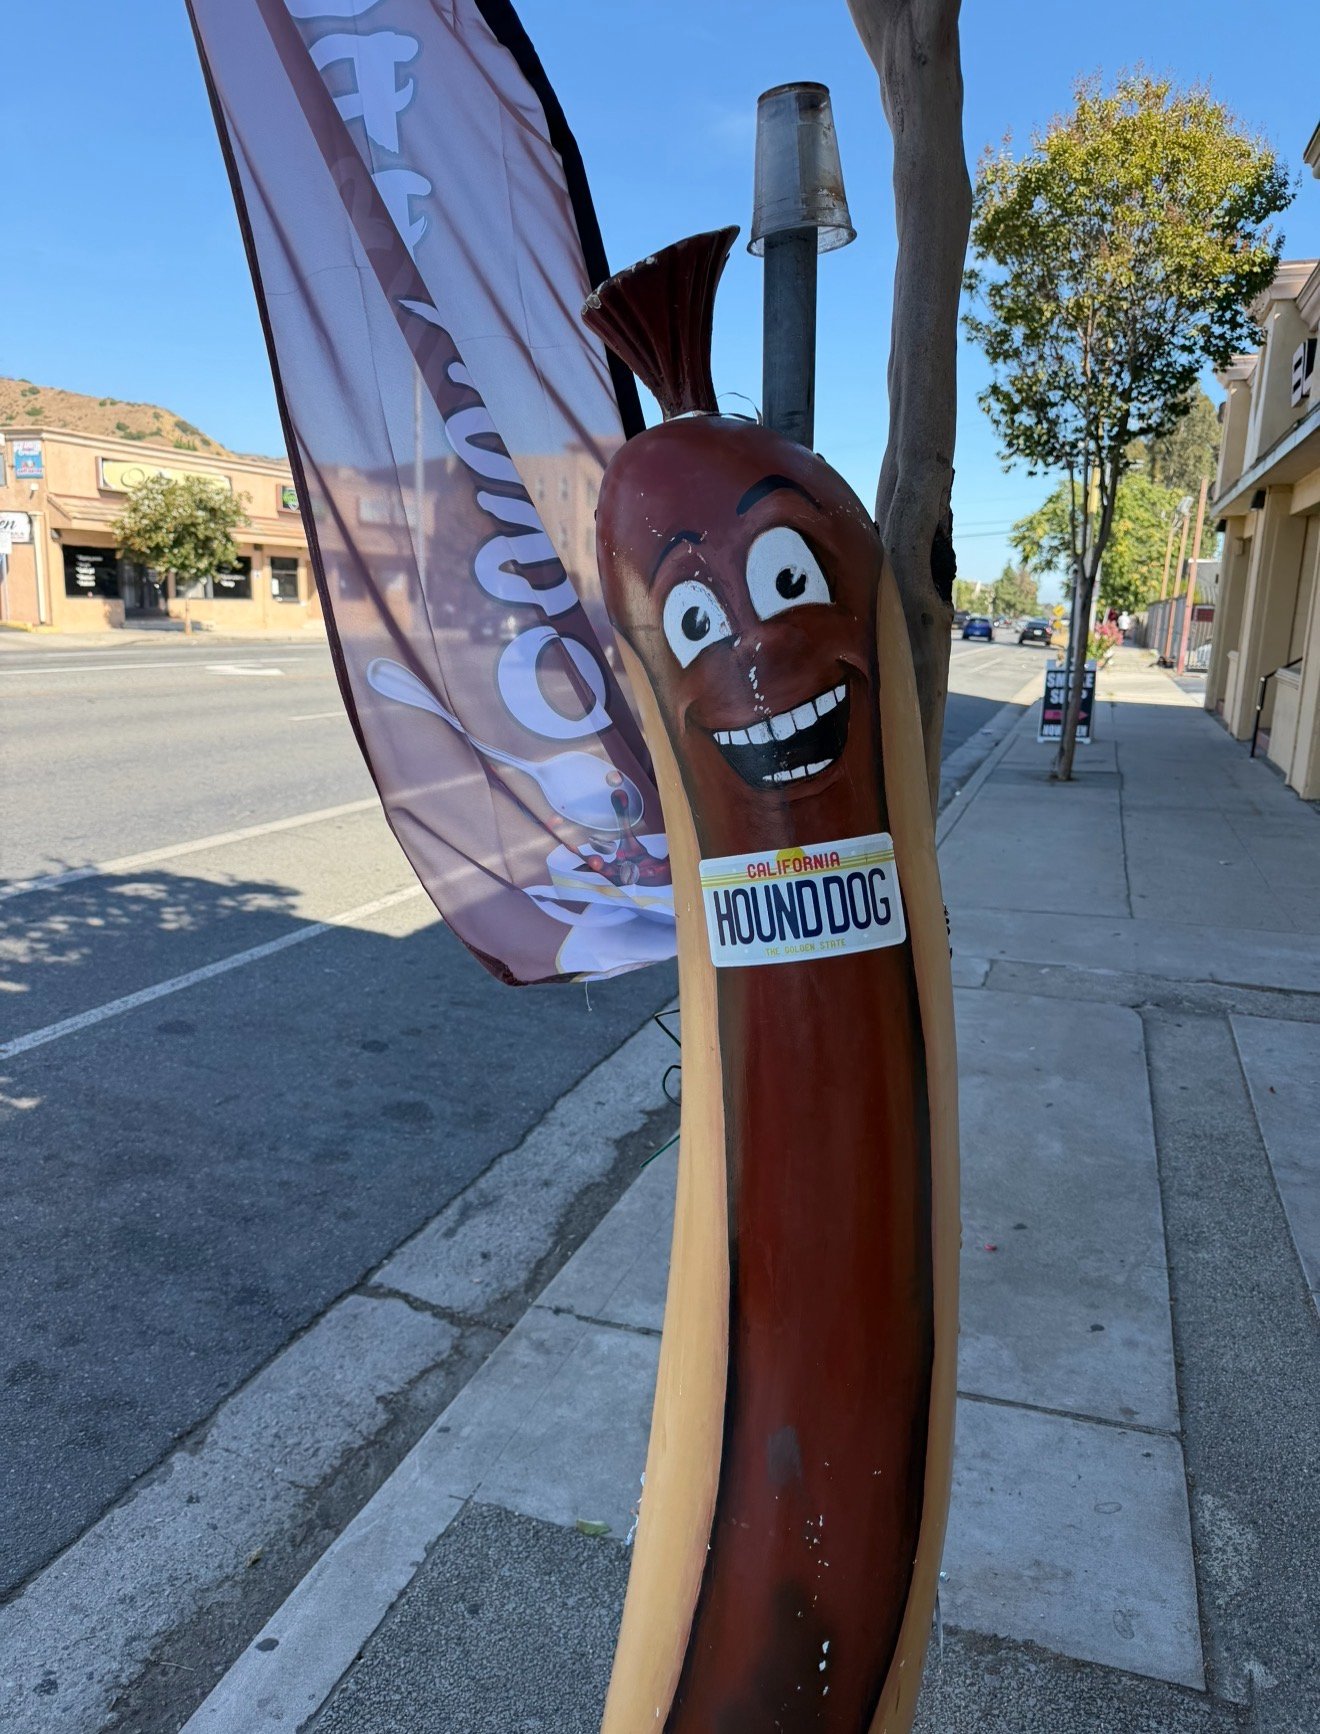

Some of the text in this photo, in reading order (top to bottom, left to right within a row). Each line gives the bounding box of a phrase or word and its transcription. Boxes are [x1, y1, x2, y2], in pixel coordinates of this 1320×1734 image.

[747, 852, 841, 878] CALIFORNIA
[713, 868, 891, 946] HOUND DOG
[765, 939, 847, 956] THE GOLDEN STATE
